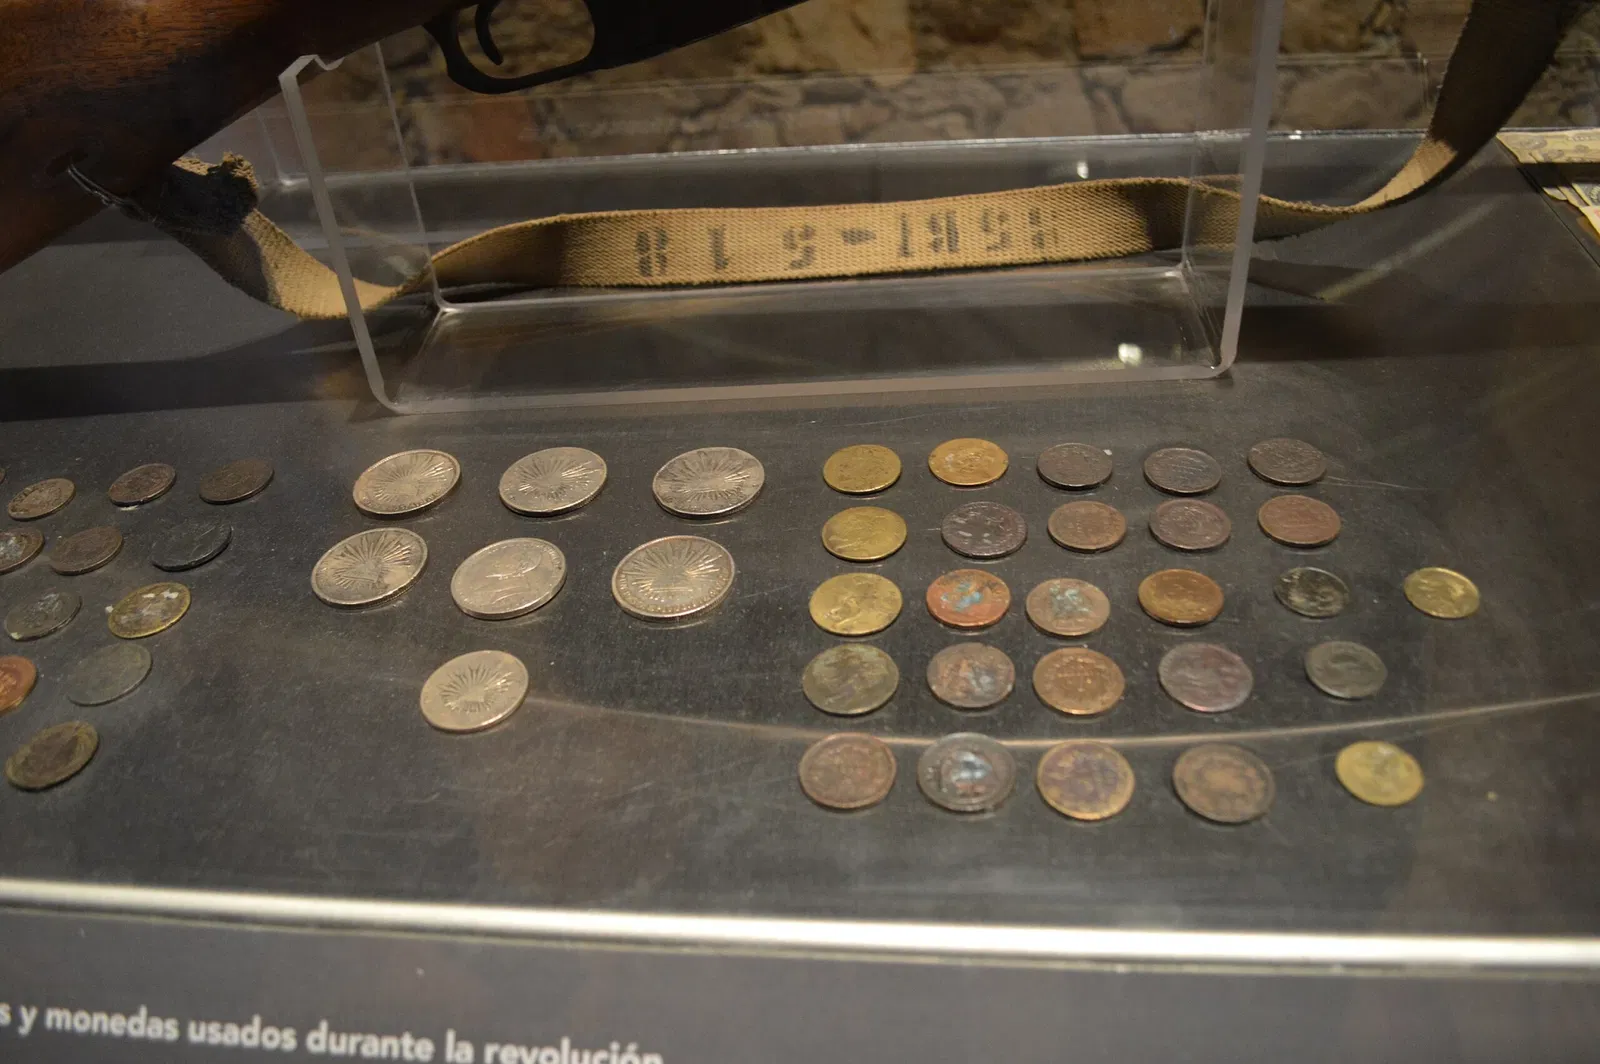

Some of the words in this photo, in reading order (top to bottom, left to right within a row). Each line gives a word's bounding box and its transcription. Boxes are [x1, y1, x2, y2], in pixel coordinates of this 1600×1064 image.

[18, 1004, 38, 1036] y
[46, 1006, 180, 1041] monedas
[189, 1014, 298, 1051] usados
[307, 1020, 435, 1061] durante
[445, 1028, 475, 1064] la
